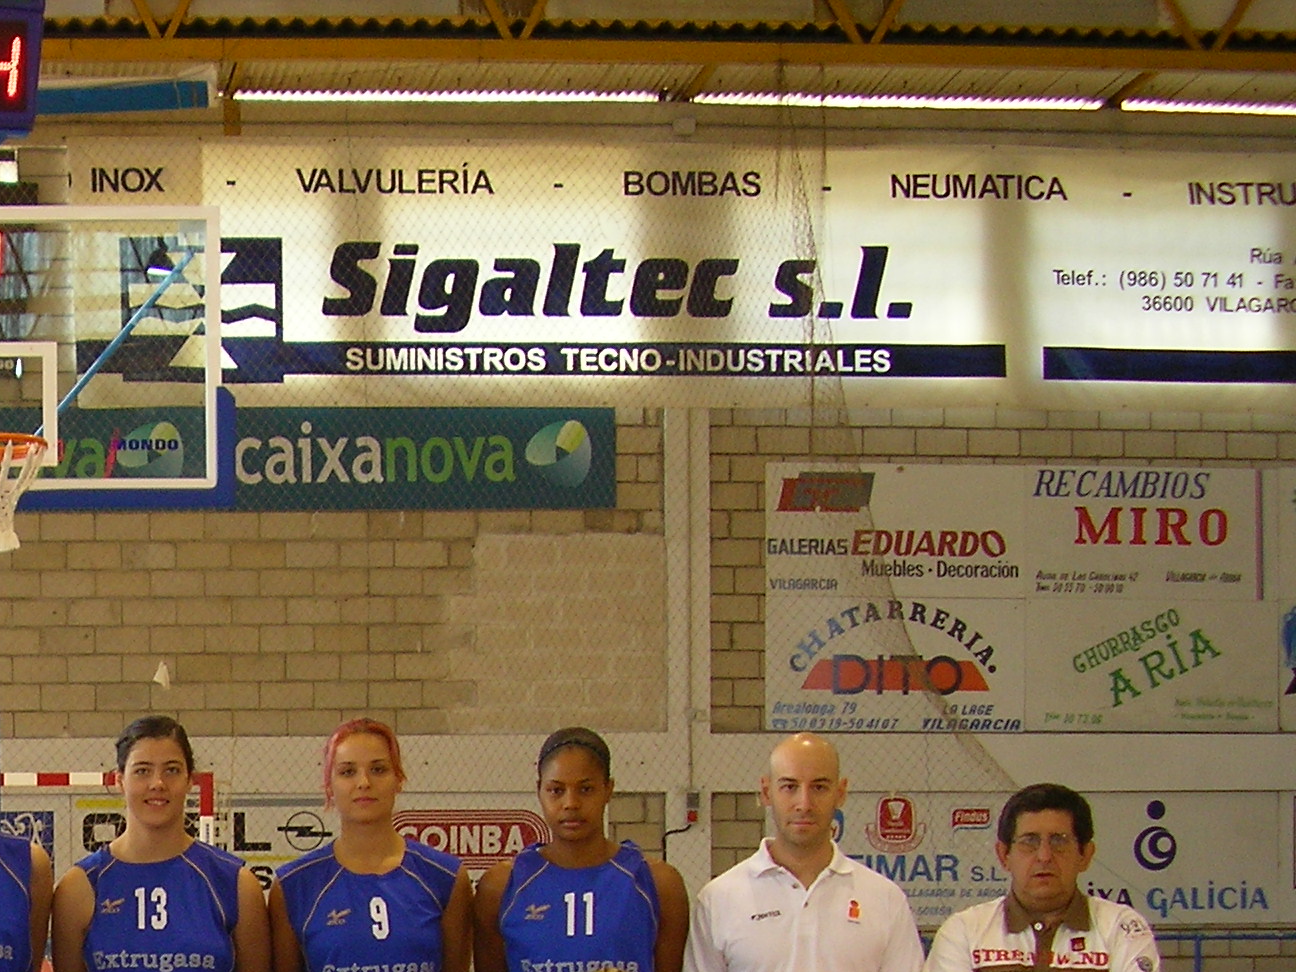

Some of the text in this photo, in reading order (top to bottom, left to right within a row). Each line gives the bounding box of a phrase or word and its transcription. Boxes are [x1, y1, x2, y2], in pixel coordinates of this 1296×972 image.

[91, 162, 1296, 206] INOX VALVULERÍA BOMBAS NEUMATICA INSTRU
[1250, 248, 1282, 264] Rúa
[321, 241, 913, 333] Sigaltec s.l.
[1053, 269, 1107, 286] Telef.:
[1119, 271, 1166, 291] (986)
[1174, 272, 1194, 288] 50
[1202, 273, 1218, 288] 71
[1226, 273, 1243, 288] 41
[1142, 295, 1194, 312] 36600
[345, 347, 546, 373] SUMINISTROS
[117, 438, 180, 452] MONDO
[235, 421, 516, 484] caixanova
[1033, 470, 1210, 499] RECAMBIOS
[1074, 506, 1228, 546] MIRO
[768, 530, 1006, 558] GALERIAS EDUARDO
[861, 560, 924, 578] Muebles
[936, 560, 1019, 578] Decoración
[770, 578, 838, 591] VILAGARCIA
[832, 654, 963, 695] DITO
[921, 718, 1022, 731] VILAGARCIA
[954, 810, 989, 824] Findus
[83, 813, 272, 851] OEL
[971, 866, 1007, 882] S.L.
[903, 888, 956, 898] ILLAGARCIA
[134, 887, 169, 931] 13
[369, 896, 391, 941] 9
[563, 891, 595, 937] 11
